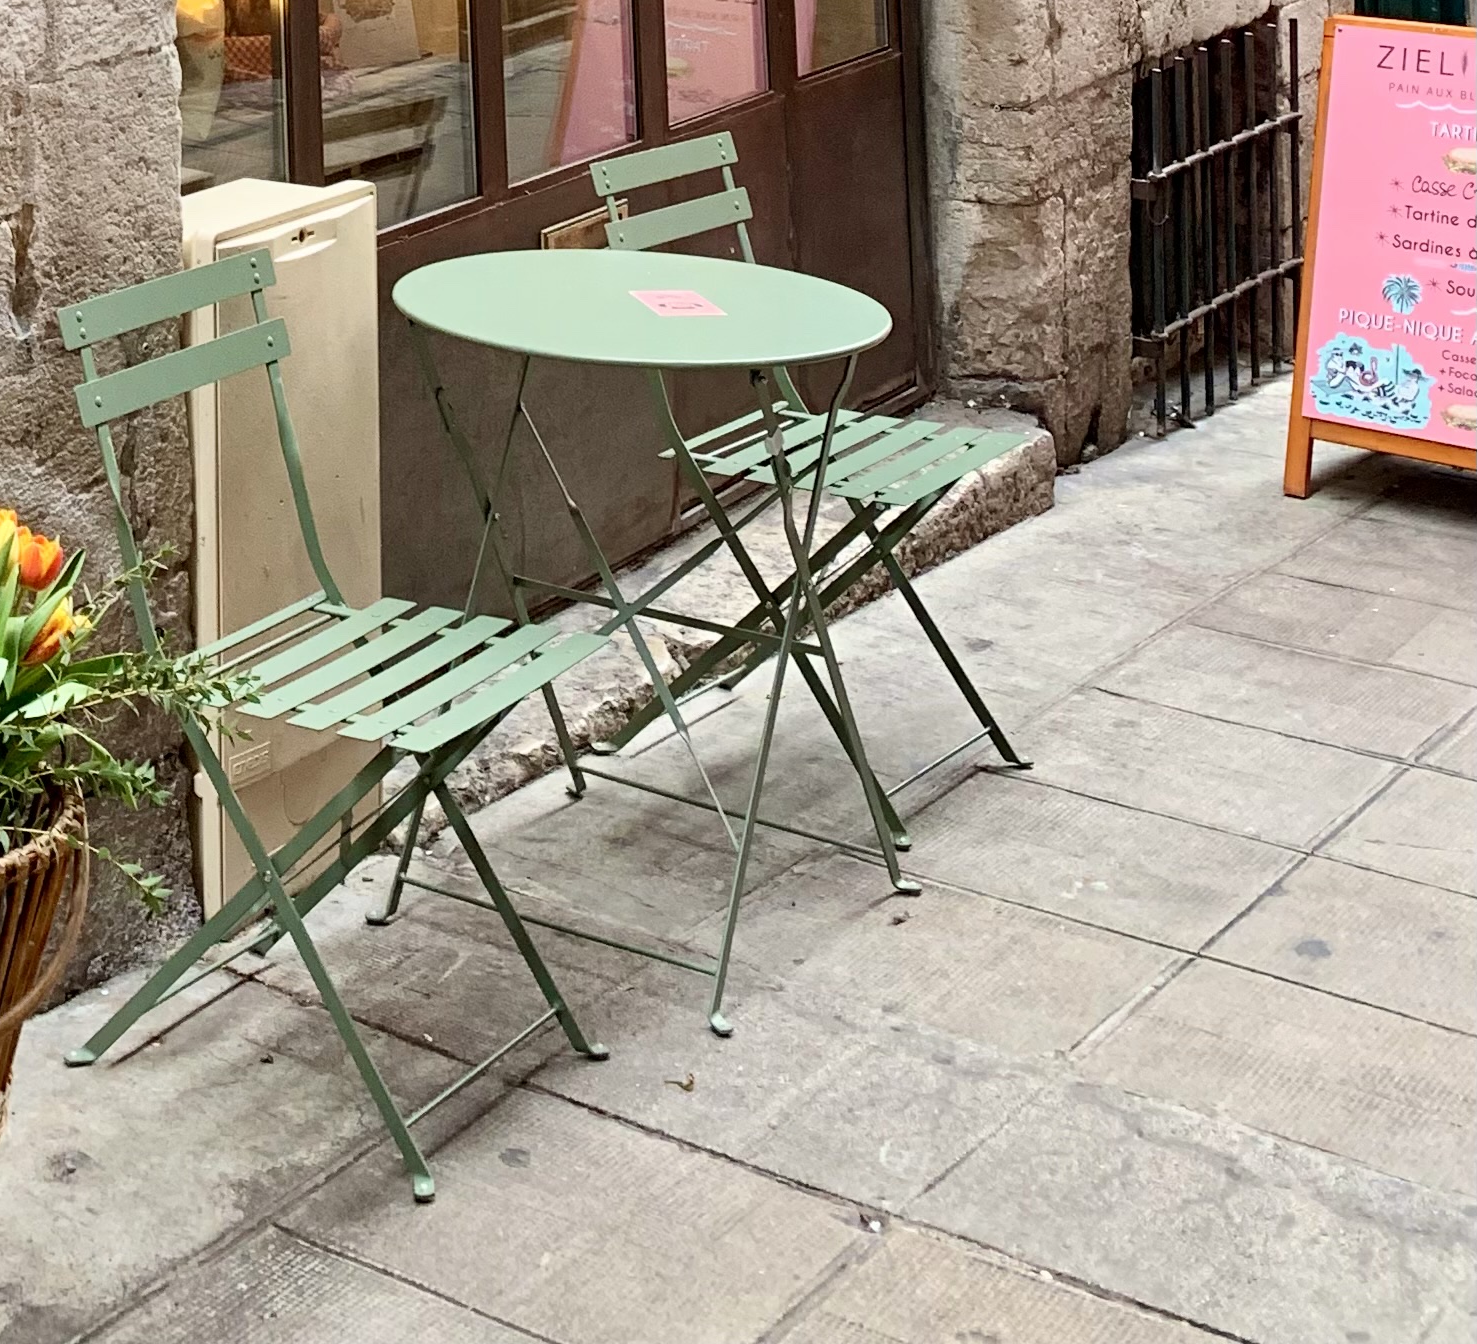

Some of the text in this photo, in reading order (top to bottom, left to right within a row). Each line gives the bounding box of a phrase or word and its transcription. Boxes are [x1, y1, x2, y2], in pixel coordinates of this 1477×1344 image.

[1388, 82, 1420, 95] PAIN
[1426, 86, 1453, 99] AUX
[1411, 175, 1457, 198] Casse
[1404, 204, 1461, 227] Tartine
[1392, 233, 1462, 258] Sardines
[1445, 279, 1476, 298] Sou
[1338, 307, 1465, 344] PIQUE-NIQUE
[1441, 348, 1477, 366] Casse
